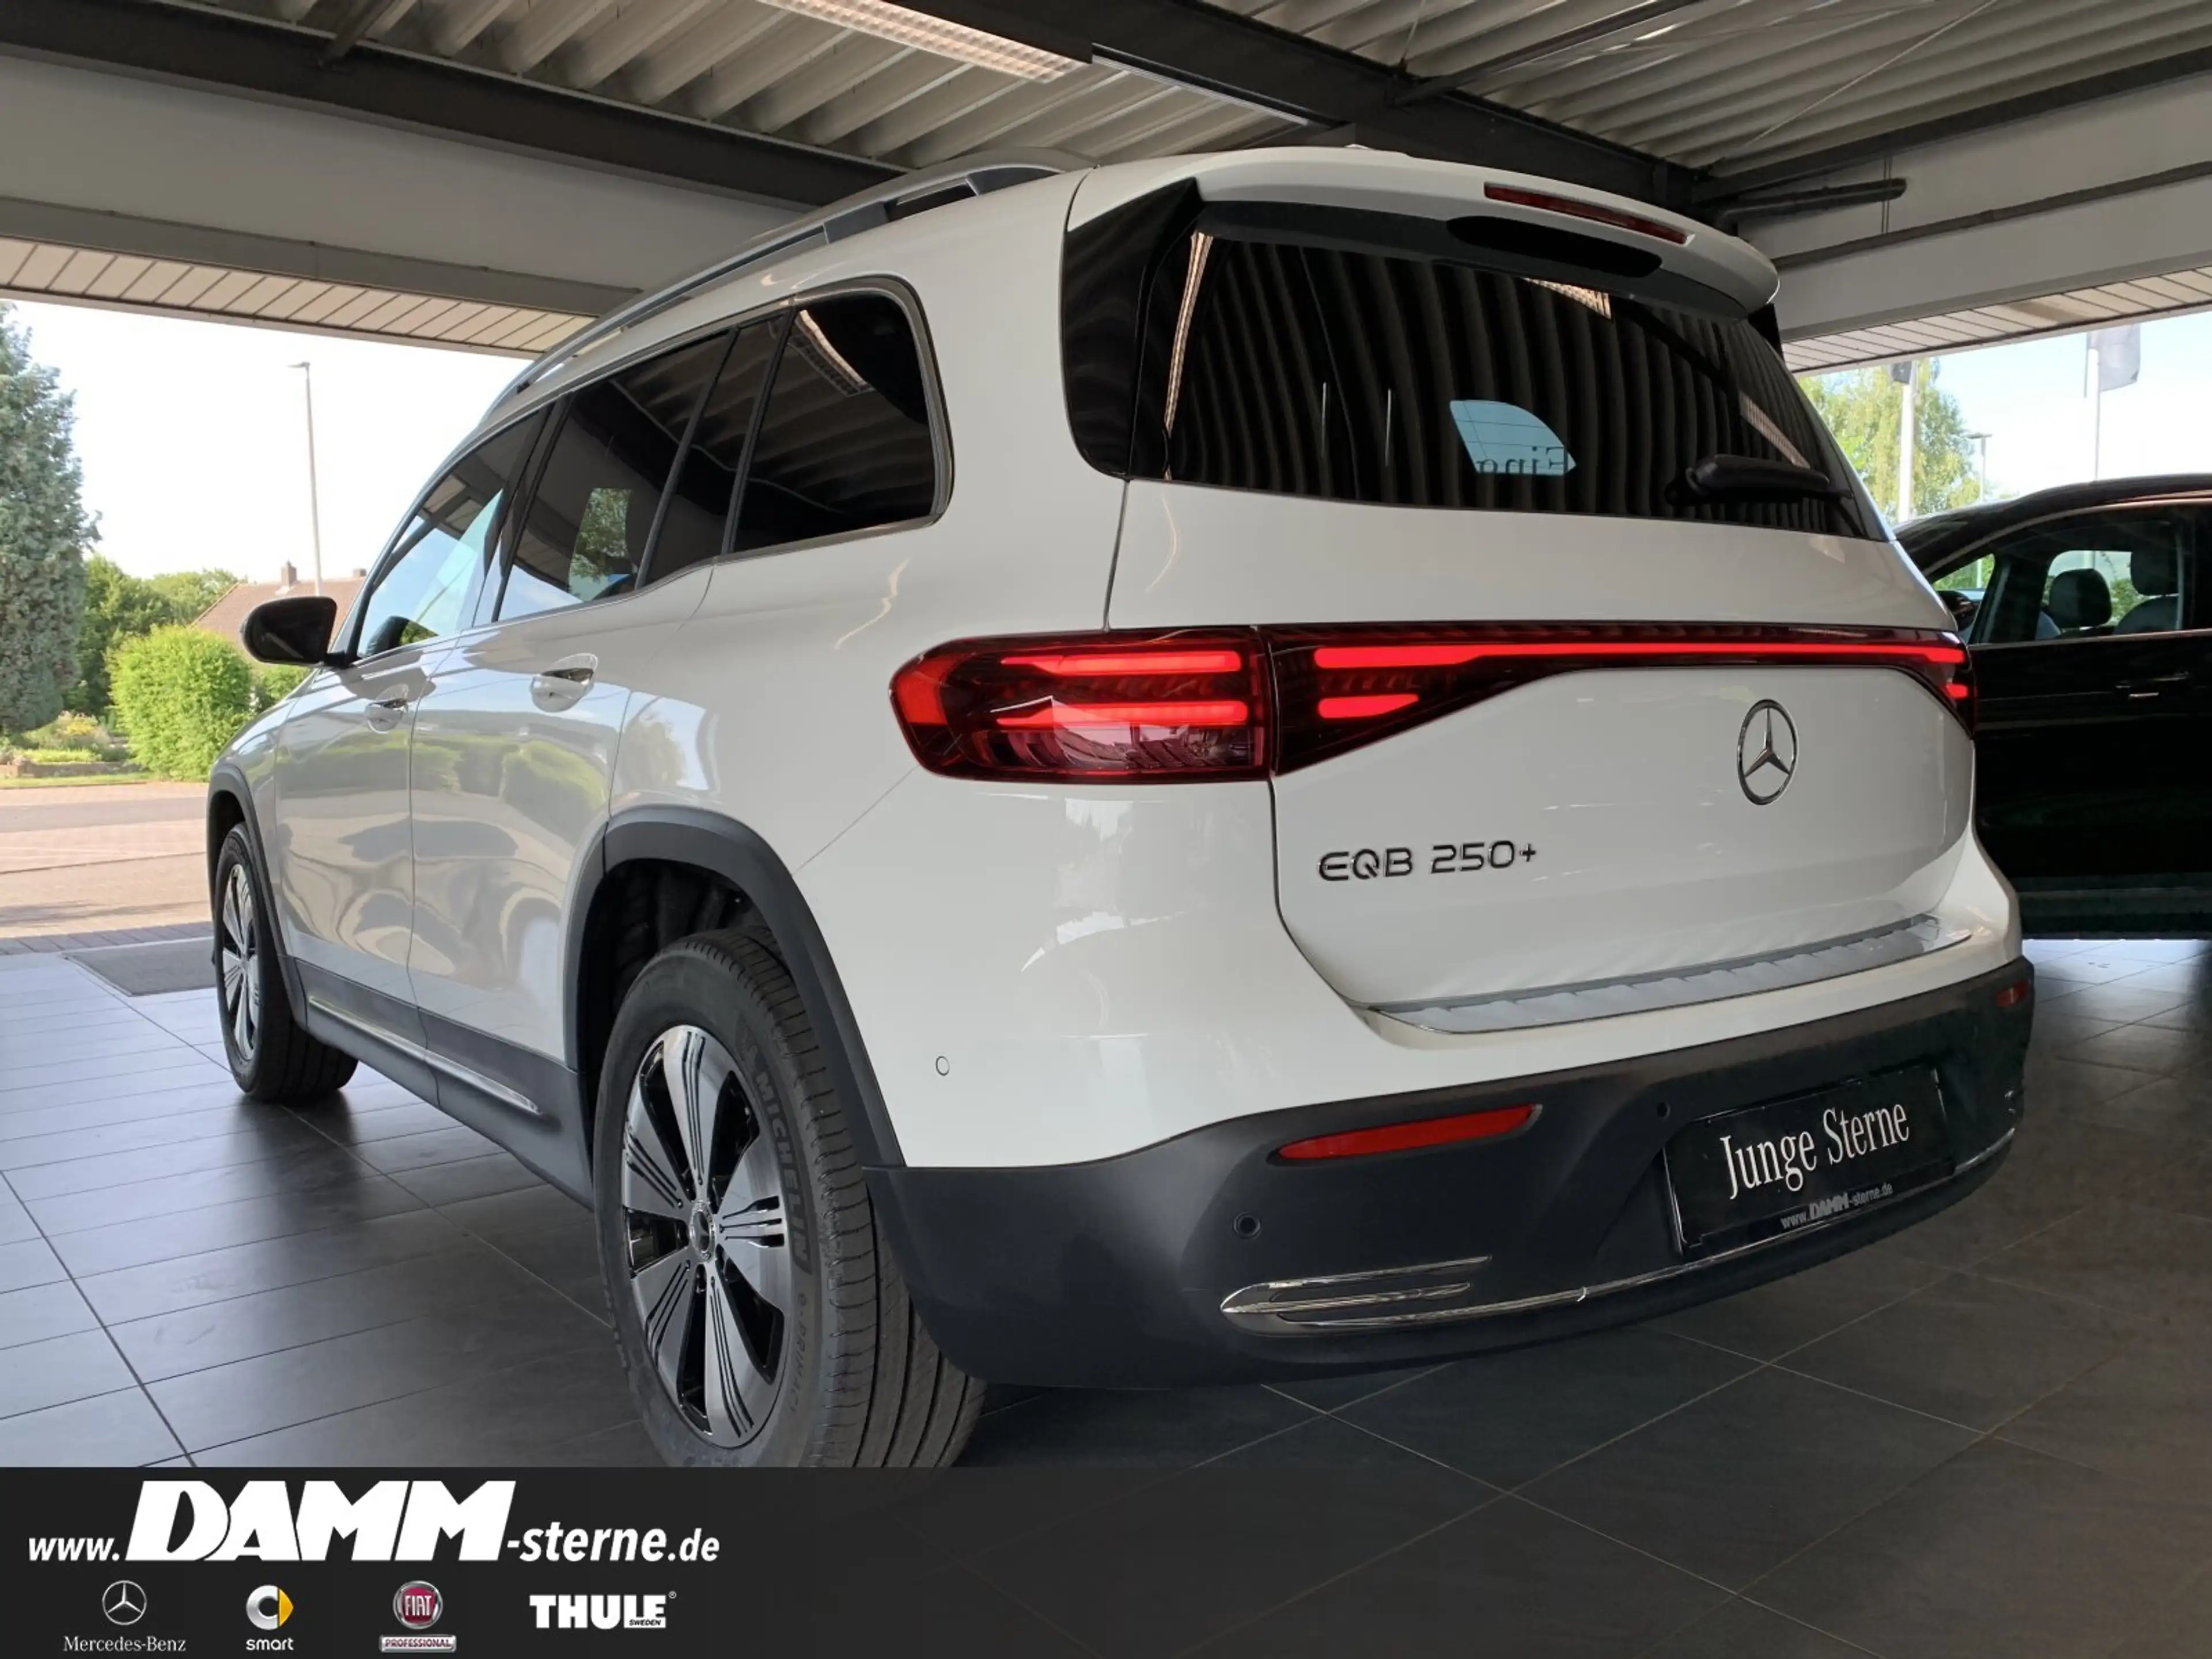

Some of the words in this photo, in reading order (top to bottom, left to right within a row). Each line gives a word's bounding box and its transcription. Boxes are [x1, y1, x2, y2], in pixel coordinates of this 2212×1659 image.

[1319, 847, 1413, 881] EQB
[1431, 840, 1537, 874] 250+
[755, 1070, 809, 1263] MICHELIN
[1719, 1131, 1817, 1200] Junge
[1823, 1104, 1910, 1165] Sterne
[1780, 1181, 1893, 1229] www.DAMM-sterne.de
